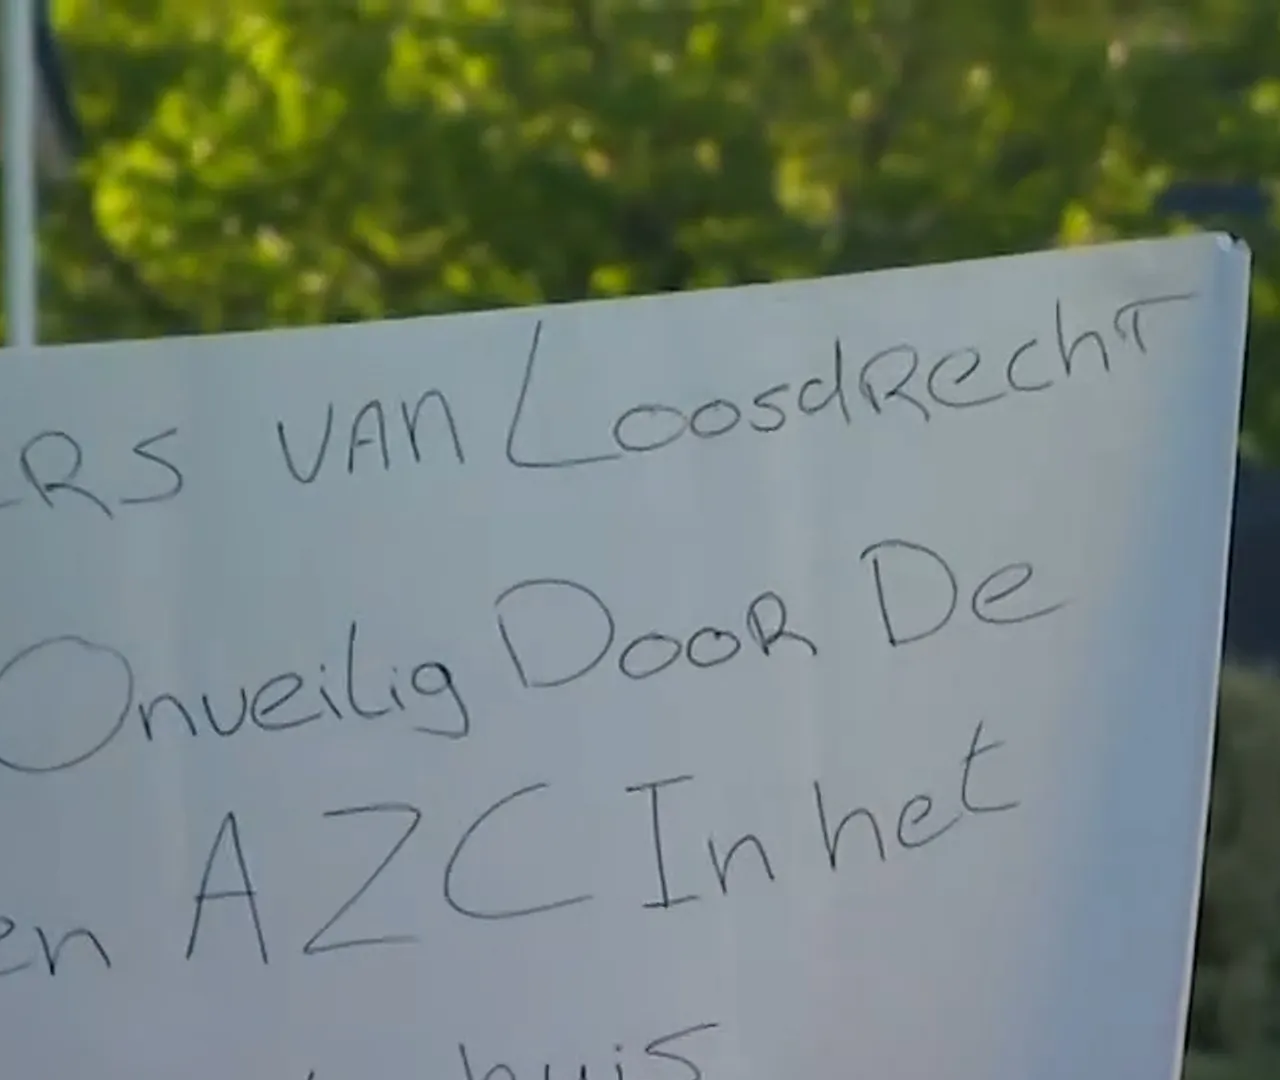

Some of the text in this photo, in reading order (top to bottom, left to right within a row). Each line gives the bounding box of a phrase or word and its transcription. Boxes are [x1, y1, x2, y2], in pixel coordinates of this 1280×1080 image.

[859, 539, 1070, 648] De
[185, 780, 595, 964] AZC
[624, 774, 776, 912] In
[813, 719, 1022, 873] het
